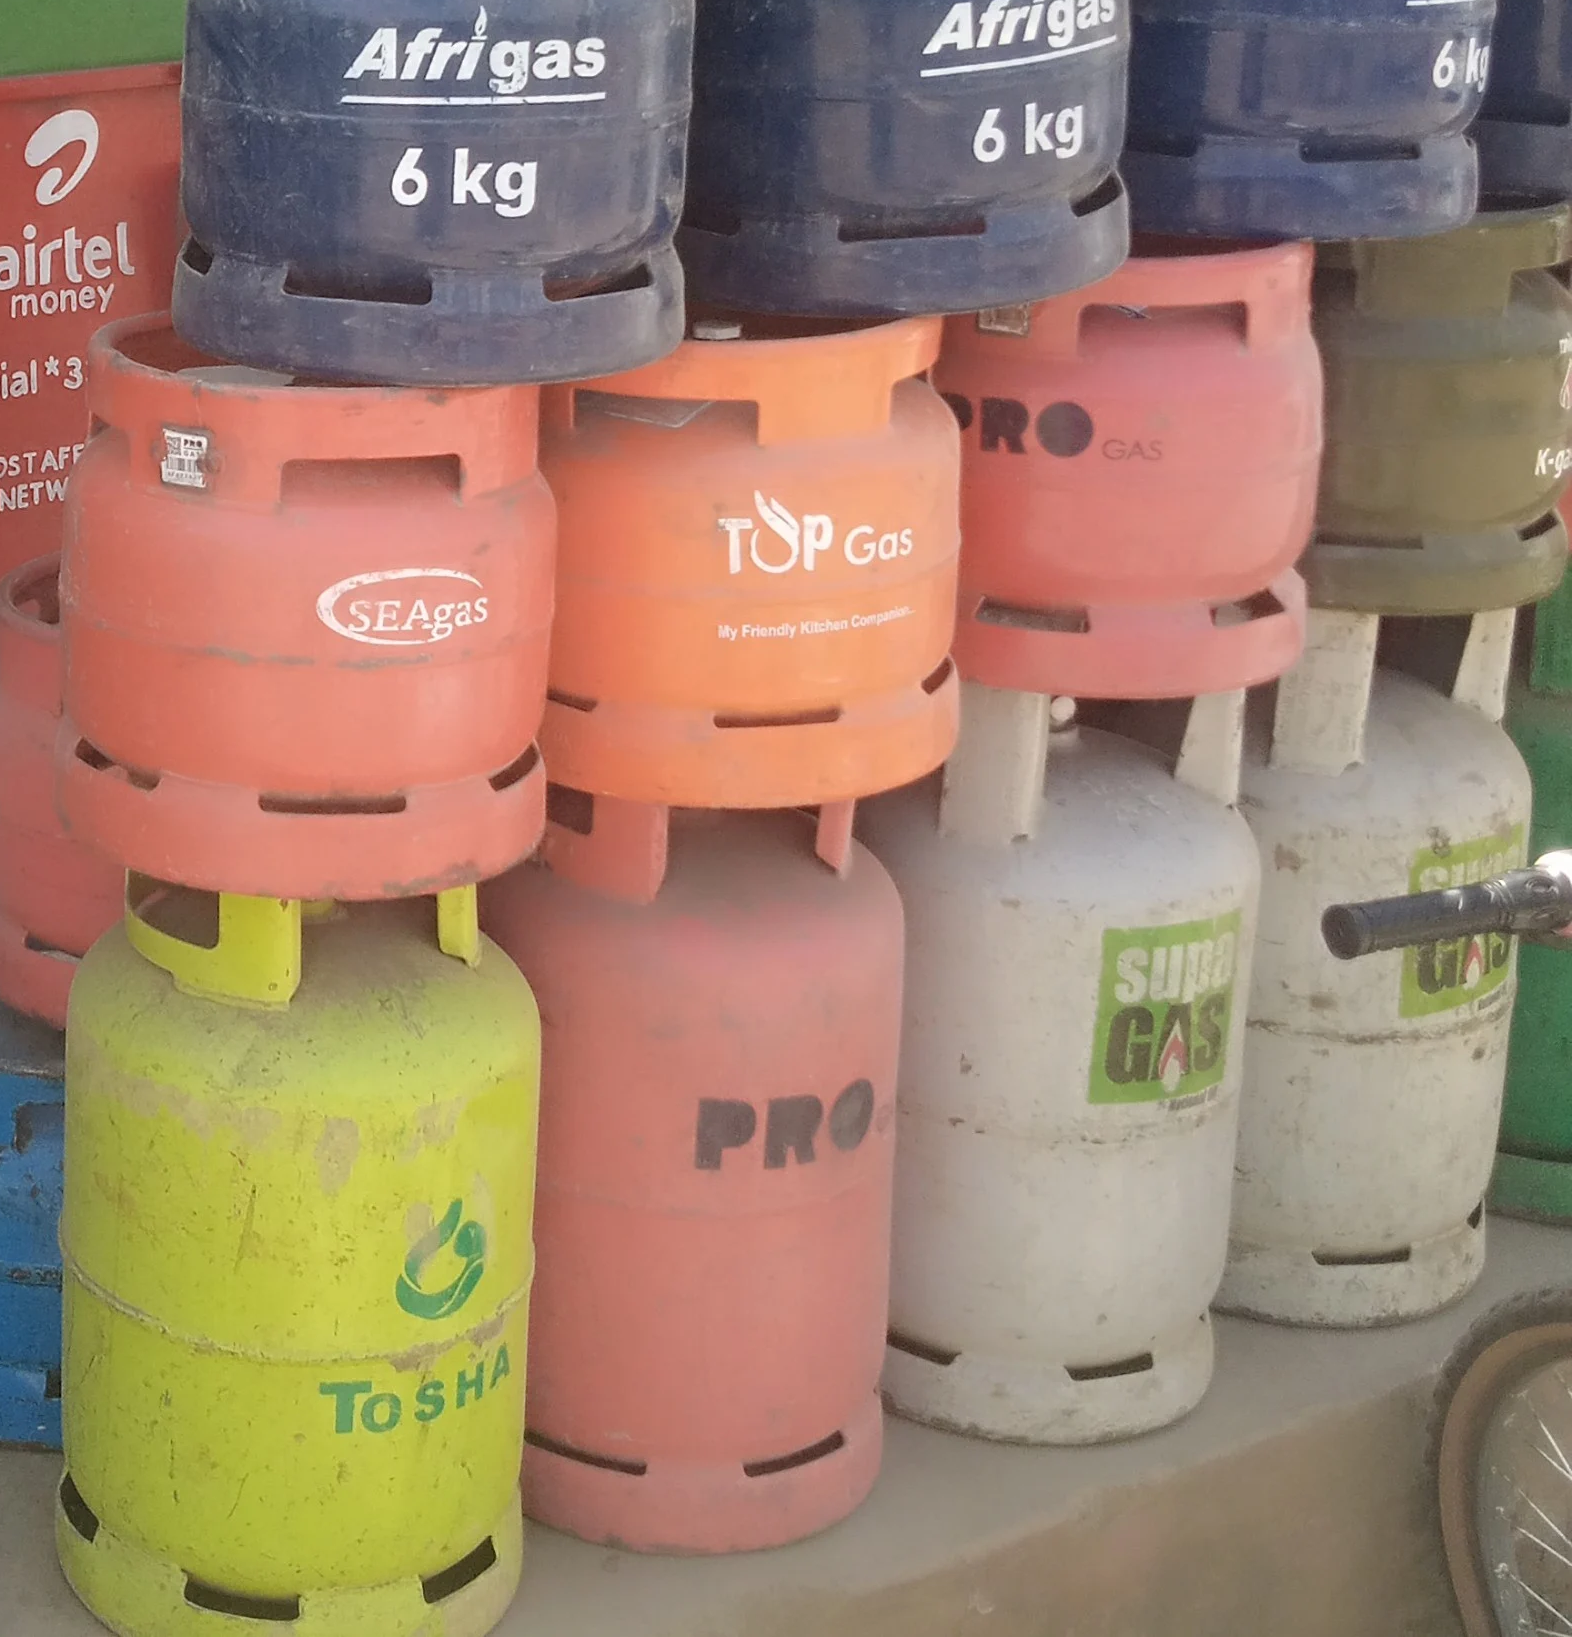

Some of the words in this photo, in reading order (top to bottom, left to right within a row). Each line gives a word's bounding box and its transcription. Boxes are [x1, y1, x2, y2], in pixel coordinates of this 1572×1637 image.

[343, 6, 607, 95] Afrigas
[1432, 39, 1456, 88] 6
[1464, 37, 1490, 93] kg
[972, 108, 1005, 163] 6
[1023, 102, 1084, 159] kg
[390, 147, 429, 207] 6
[451, 147, 539, 217] kg
[11, 283, 115, 319] money
[40, 444, 85, 474] AFF
[1102, 438, 1164, 461] GAS
[1534, 447, 1572, 479] K-ga
[717, 490, 834, 575] TOP
[843, 524, 914, 566] Gas
[347, 594, 489, 643] SEAgas
[718, 623, 738, 642] My
[741, 620, 798, 640] Friendly
[800, 616, 848, 636] Kitchen
[1103, 992, 1227, 1086] GAS
[694, 1078, 874, 1170] PRO
